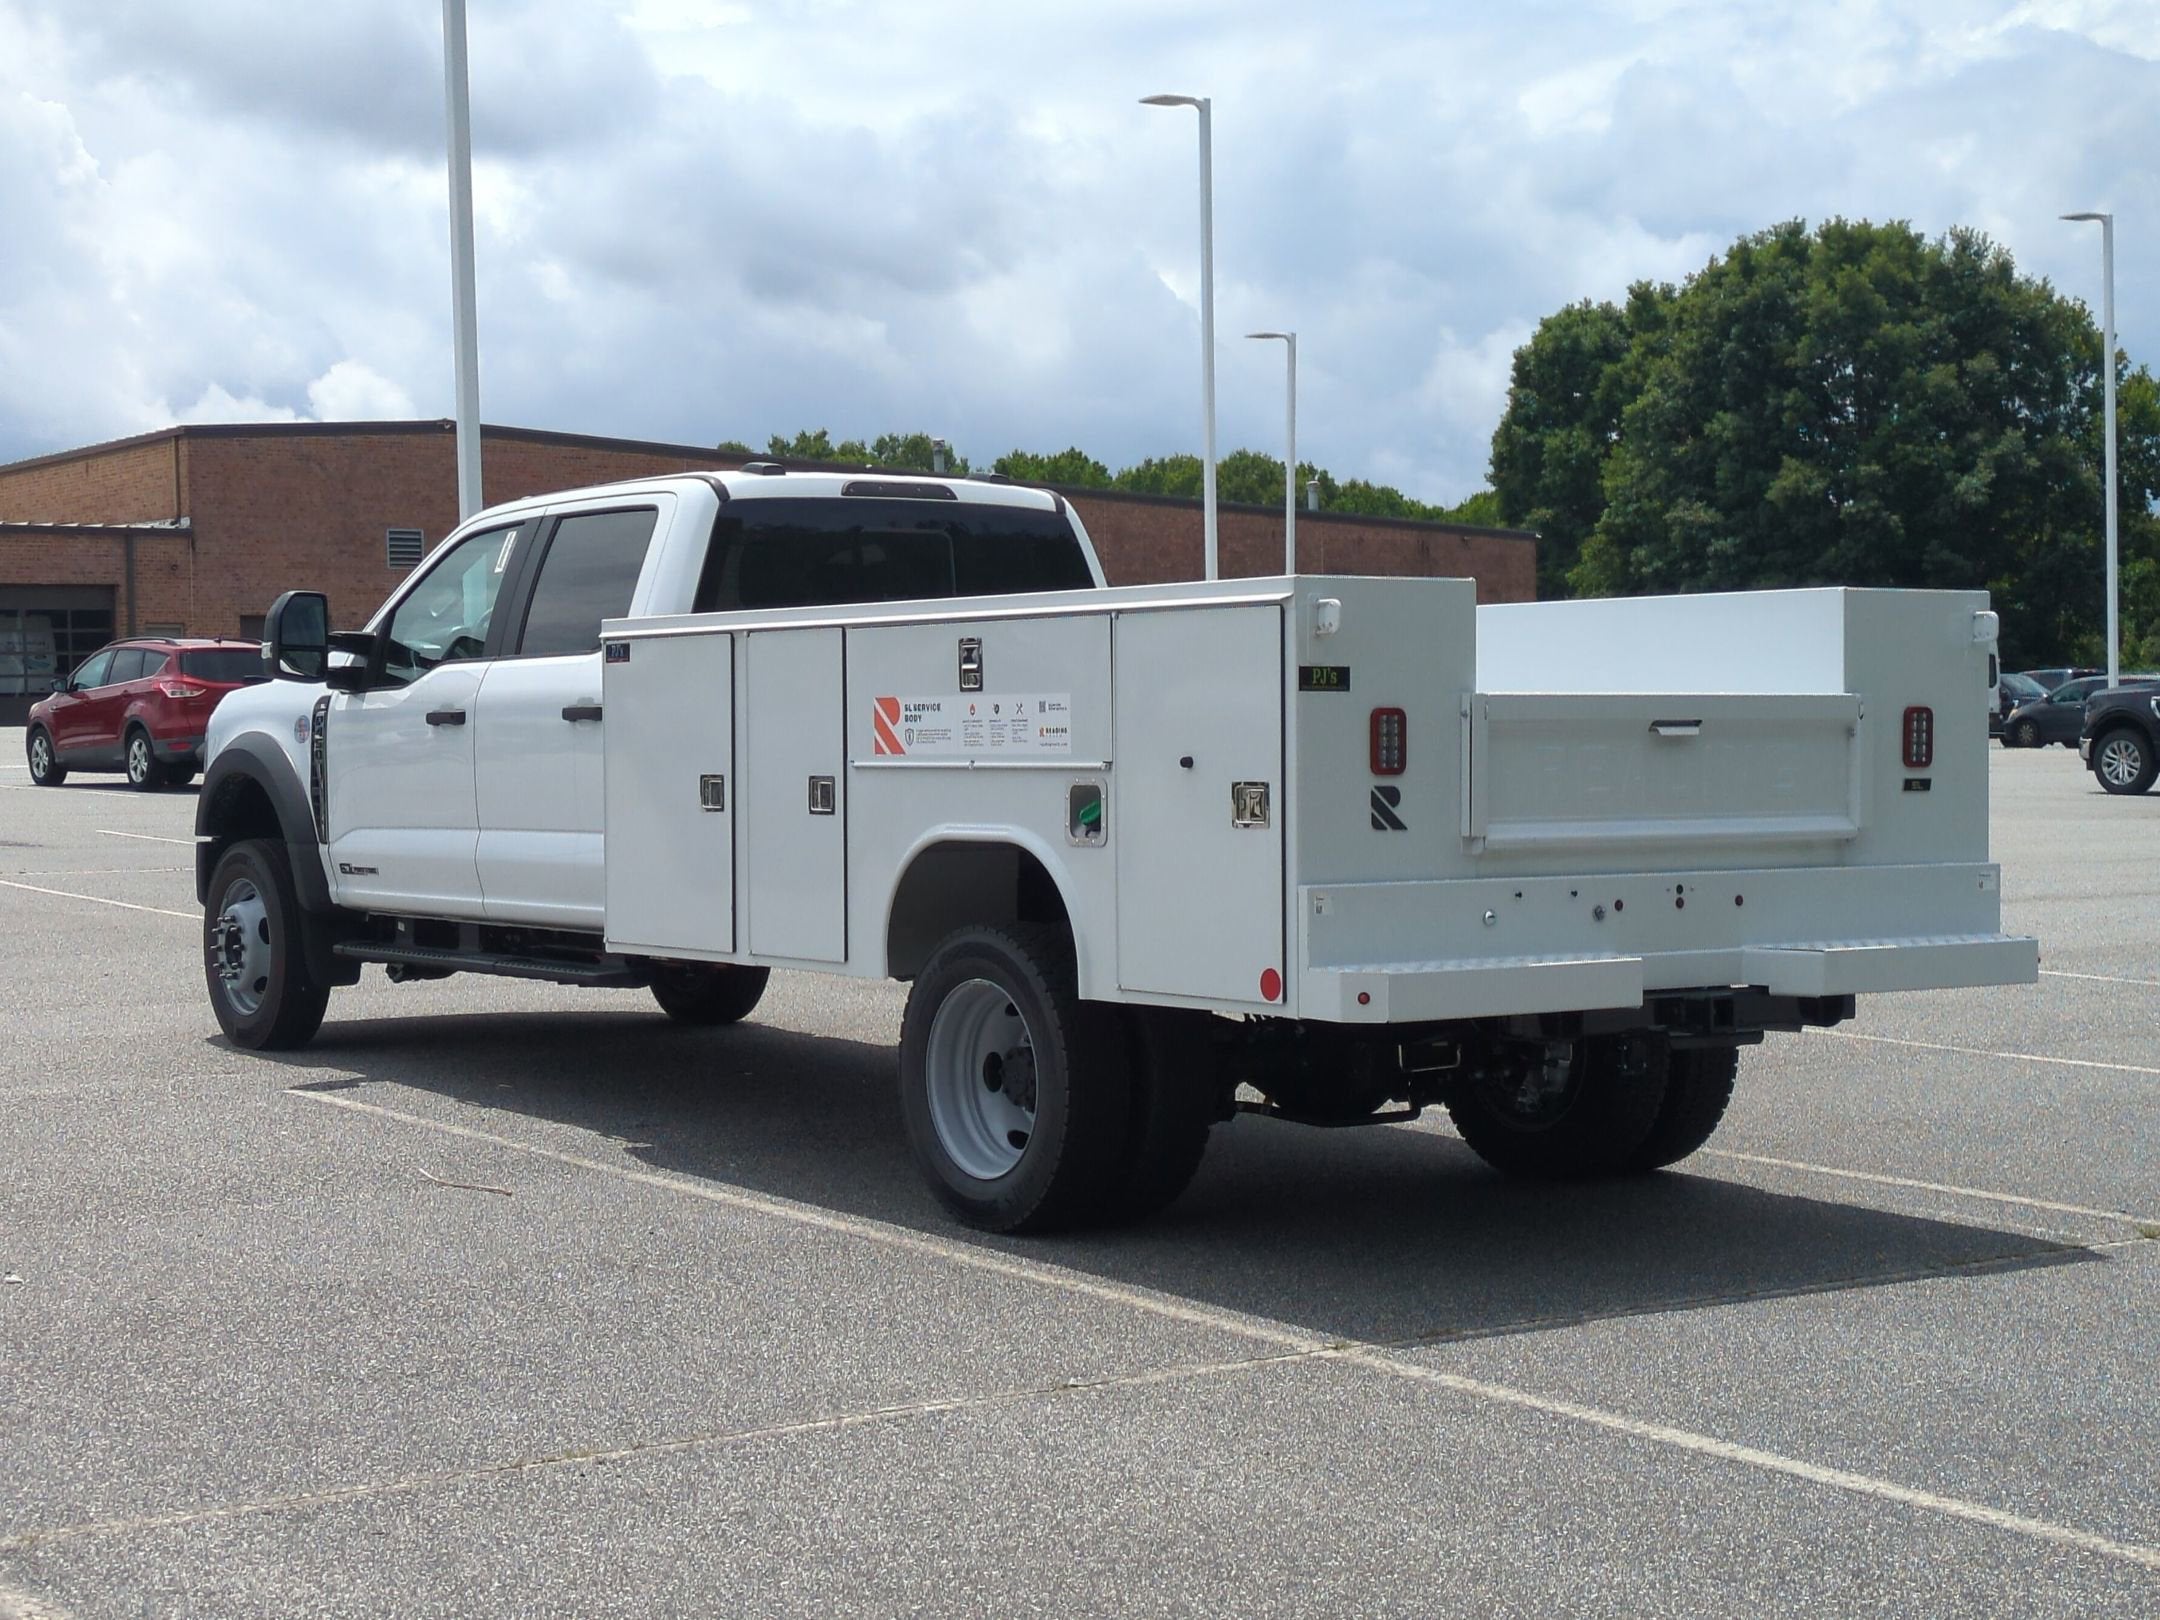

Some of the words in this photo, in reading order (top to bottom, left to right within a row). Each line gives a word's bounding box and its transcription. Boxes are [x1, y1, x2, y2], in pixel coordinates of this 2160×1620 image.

[1312, 667, 1338, 685] PJ's
[913, 702, 942, 712] SERVICE
[904, 714, 922, 723] BODY
